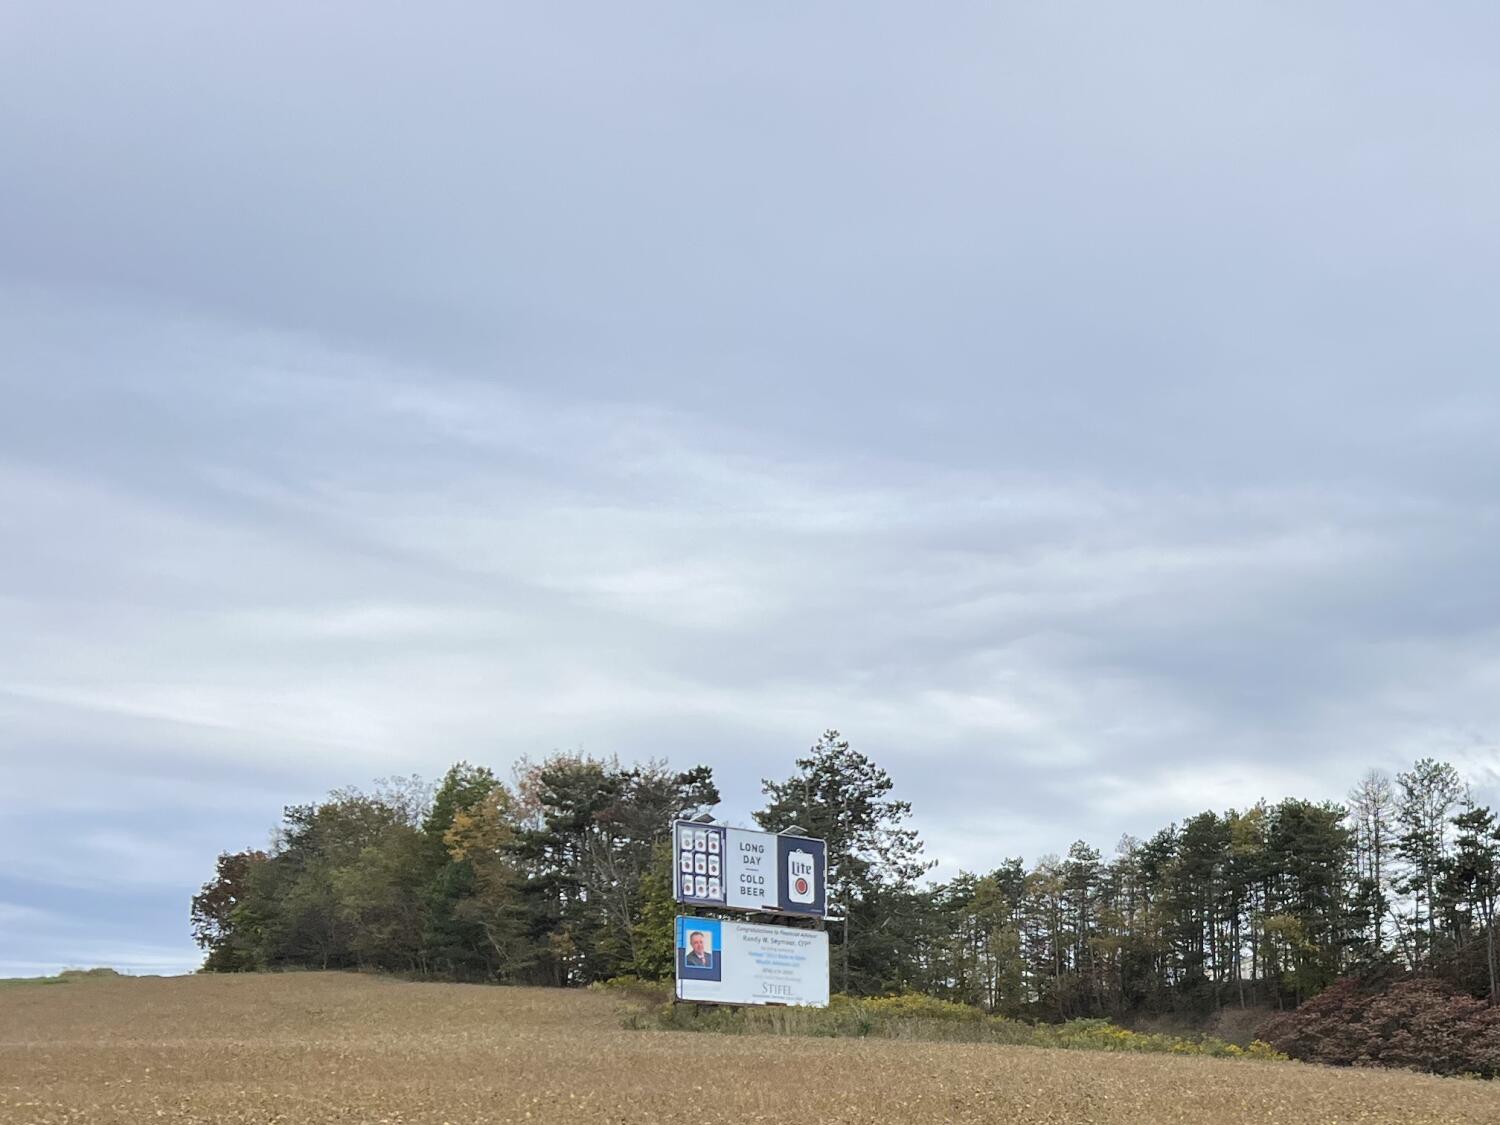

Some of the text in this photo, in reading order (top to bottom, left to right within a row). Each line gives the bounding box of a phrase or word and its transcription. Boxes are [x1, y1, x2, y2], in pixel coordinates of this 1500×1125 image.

[739, 842, 765, 854] LONG
[743, 855, 761, 866] DAY
[791, 860, 812, 876] Lite
[740, 874, 765, 885] COLD
[740, 886, 765, 897] BEER
[742, 935, 761, 943] Randy
[762, 982, 793, 996] STIFEL
